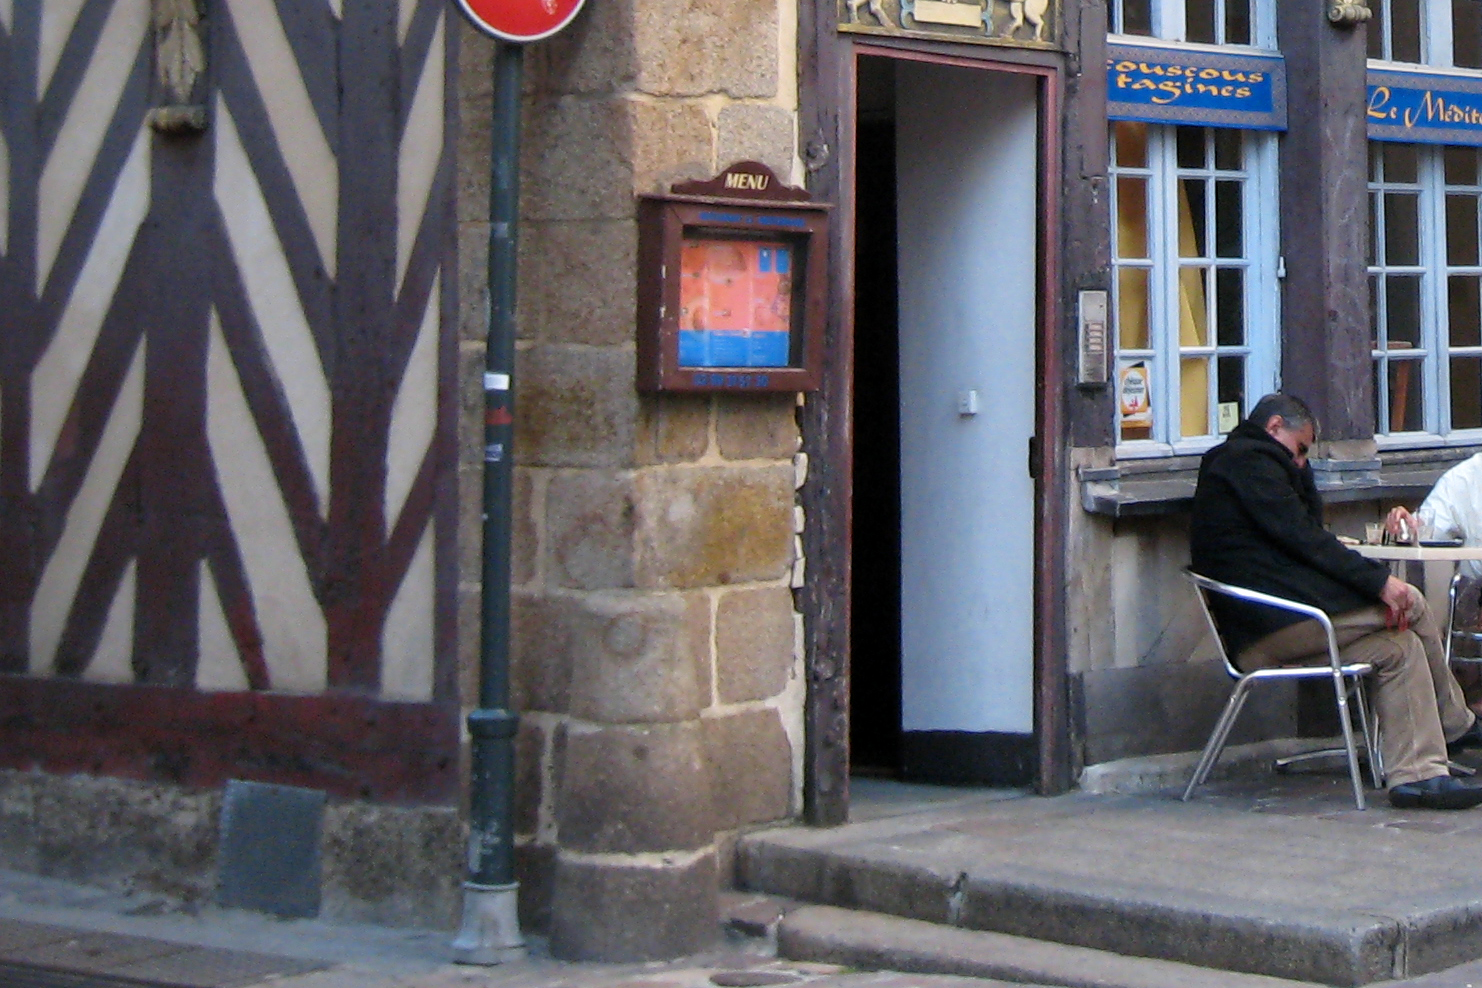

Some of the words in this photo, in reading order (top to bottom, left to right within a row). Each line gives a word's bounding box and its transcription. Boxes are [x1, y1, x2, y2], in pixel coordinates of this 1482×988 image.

[1116, 73, 1252, 104] tagines
[1367, 86, 1397, 119] Le
[724, 172, 769, 191] MENU
